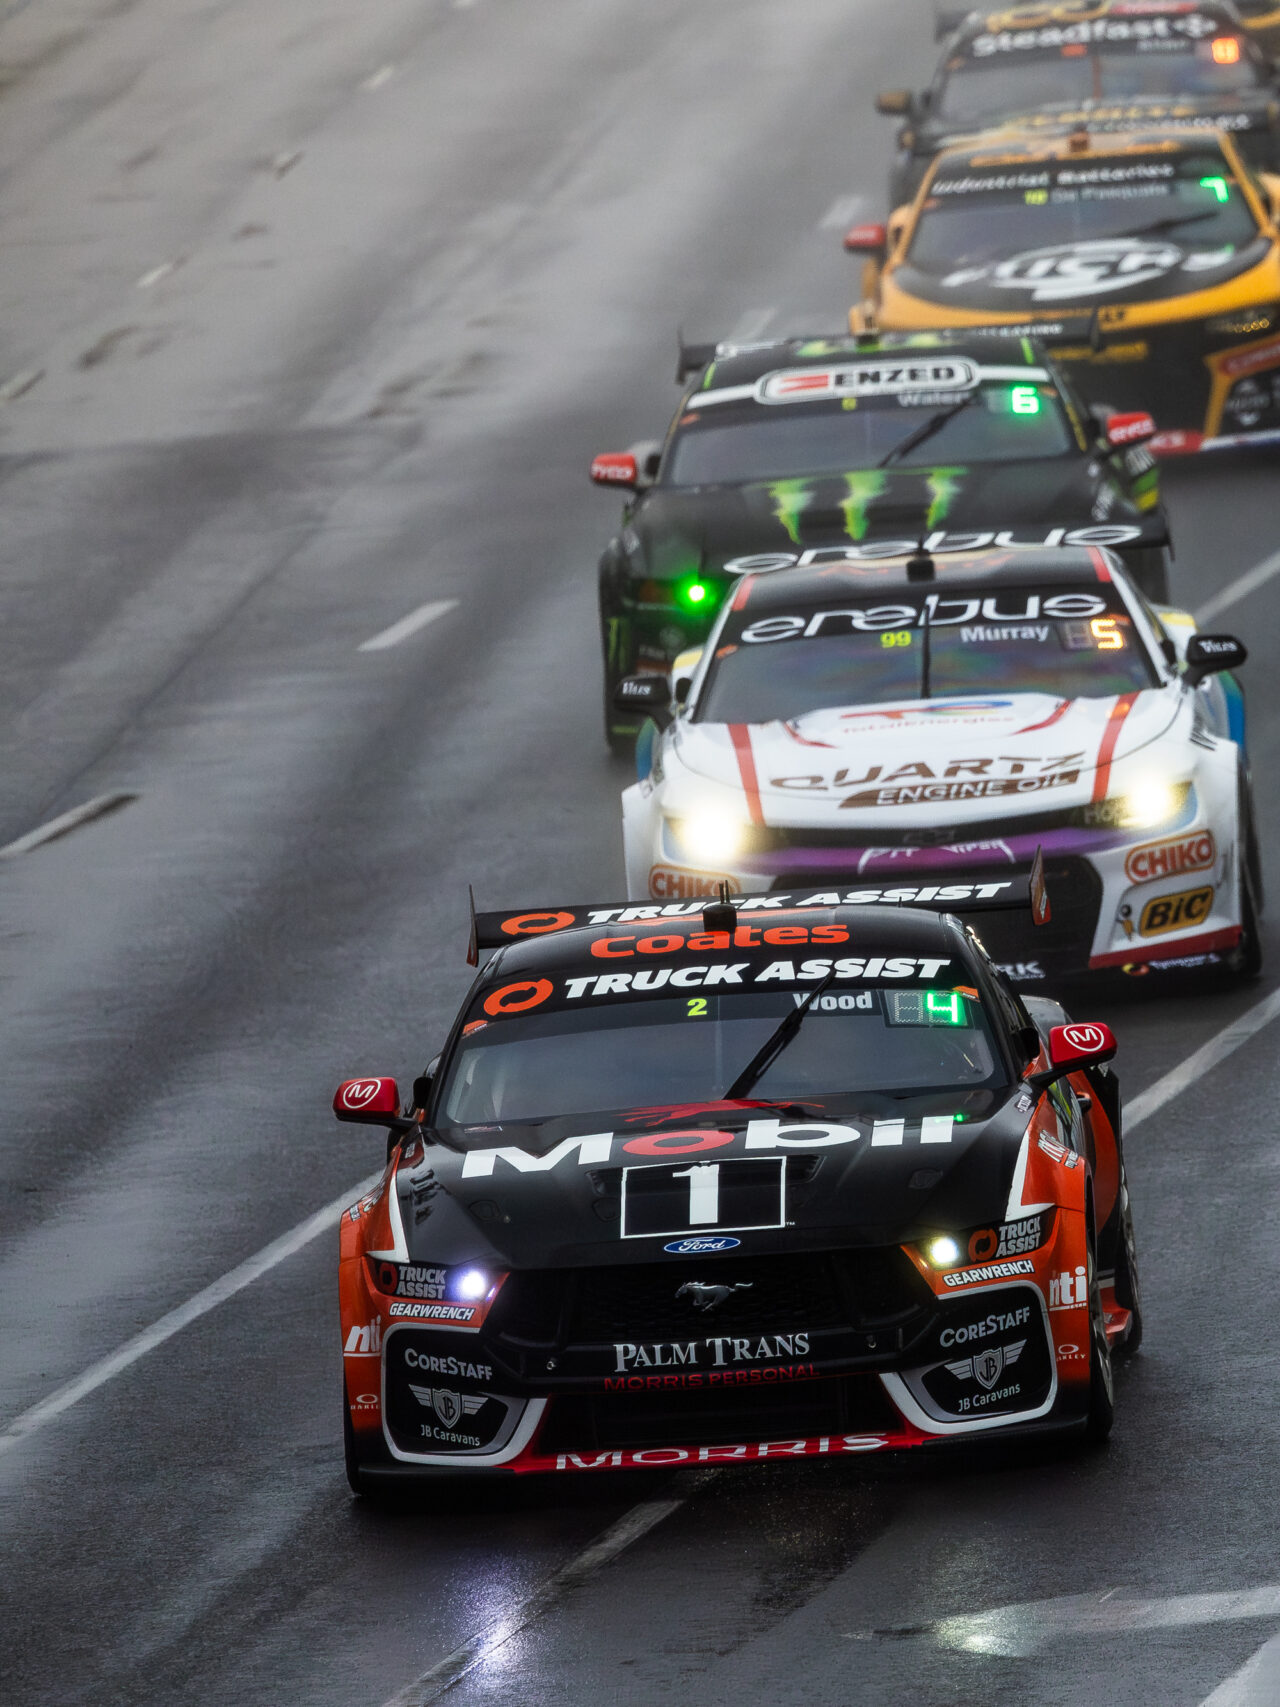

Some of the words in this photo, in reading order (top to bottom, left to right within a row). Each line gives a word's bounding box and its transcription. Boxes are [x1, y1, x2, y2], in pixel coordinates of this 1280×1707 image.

[973, 17, 1168, 57] Steadfast
[1200, 176, 1229, 203] 7
[834, 365, 956, 387] ENZED
[1011, 386, 1040, 414] 6
[880, 630, 911, 648] 99
[961, 624, 1050, 645] Murray
[1090, 619, 1124, 650] 5
[770, 751, 1086, 790] QUARTZ
[875, 777, 1012, 806] ENGINE
[1015, 769, 1074, 793] OIL
[1130, 838, 1213, 877] CHIKO
[795, 881, 1013, 906] ASSIST
[590, 923, 851, 959] Coates
[564, 962, 752, 1000] TRUCK
[754, 957, 951, 982] ASSIST
[686, 998, 708, 1017] 2
[792, 991, 873, 1012] Wood
[926, 992, 959, 1024] 4
[461, 1114, 955, 1179] Mobil
[672, 1163, 720, 1226] 1
[999, 1216, 1041, 1240] TRUCK
[677, 1237, 727, 1252] Ford
[996, 1233, 1041, 1258] ASSIST
[399, 1266, 446, 1284] TRUCK
[943, 1260, 1035, 1287] GEARWRENCH
[1049, 1266, 1087, 1306] nti
[396, 1283, 446, 1299] ASSIST
[389, 1302, 476, 1321] GEARWRENCH
[613, 1341, 698, 1372] PALM
[705, 1332, 811, 1366] TRANS
[604, 1374, 703, 1392] MORRIS
[709, 1363, 820, 1385] PERSONAL
[958, 1399, 971, 1412] JB
[973, 1383, 1021, 1408] Caravans
[420, 1424, 432, 1438] JB
[434, 1427, 481, 1447] Caravans
[555, 1432, 889, 1470] MORRIS
